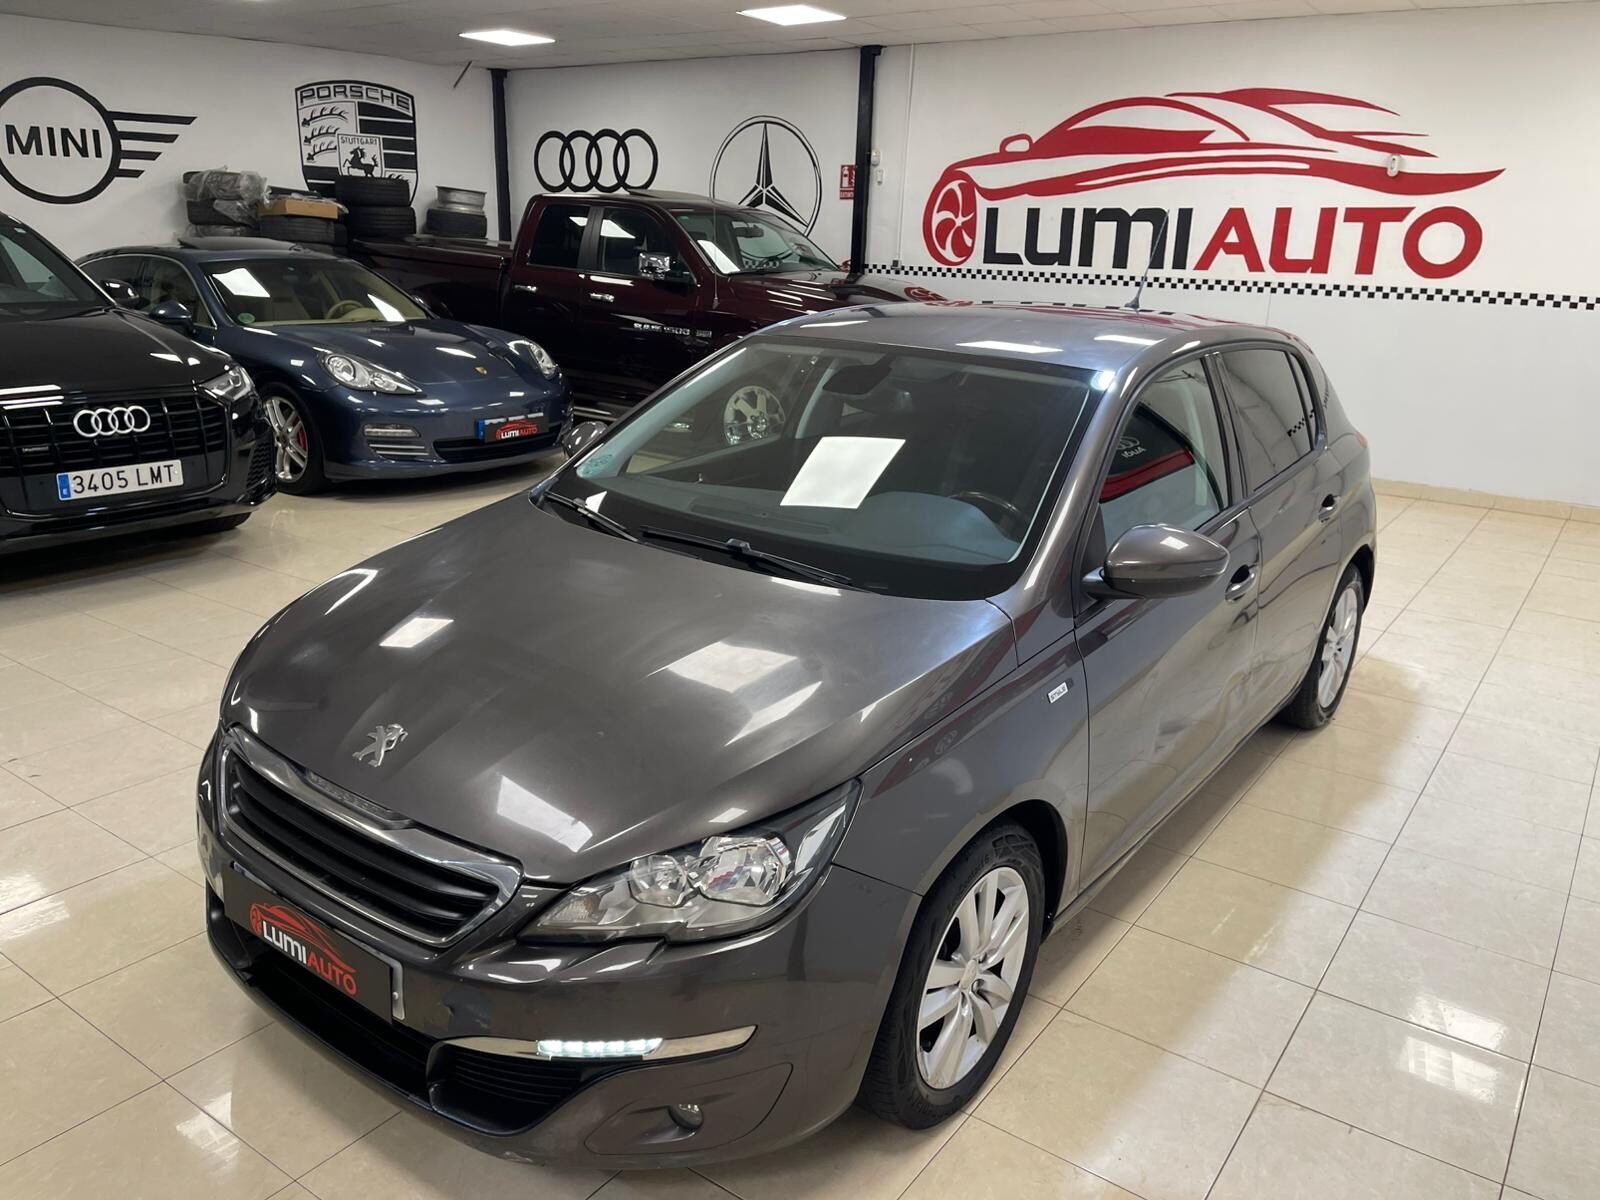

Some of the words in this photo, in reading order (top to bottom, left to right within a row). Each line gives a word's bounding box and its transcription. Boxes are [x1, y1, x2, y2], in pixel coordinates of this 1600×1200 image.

[300, 84, 411, 113] PORSCHE
[5, 124, 102, 158] MINI
[341, 136, 378, 145] STUTTGART
[73, 470, 128, 494] 3405
[136, 464, 174, 486] LMT
